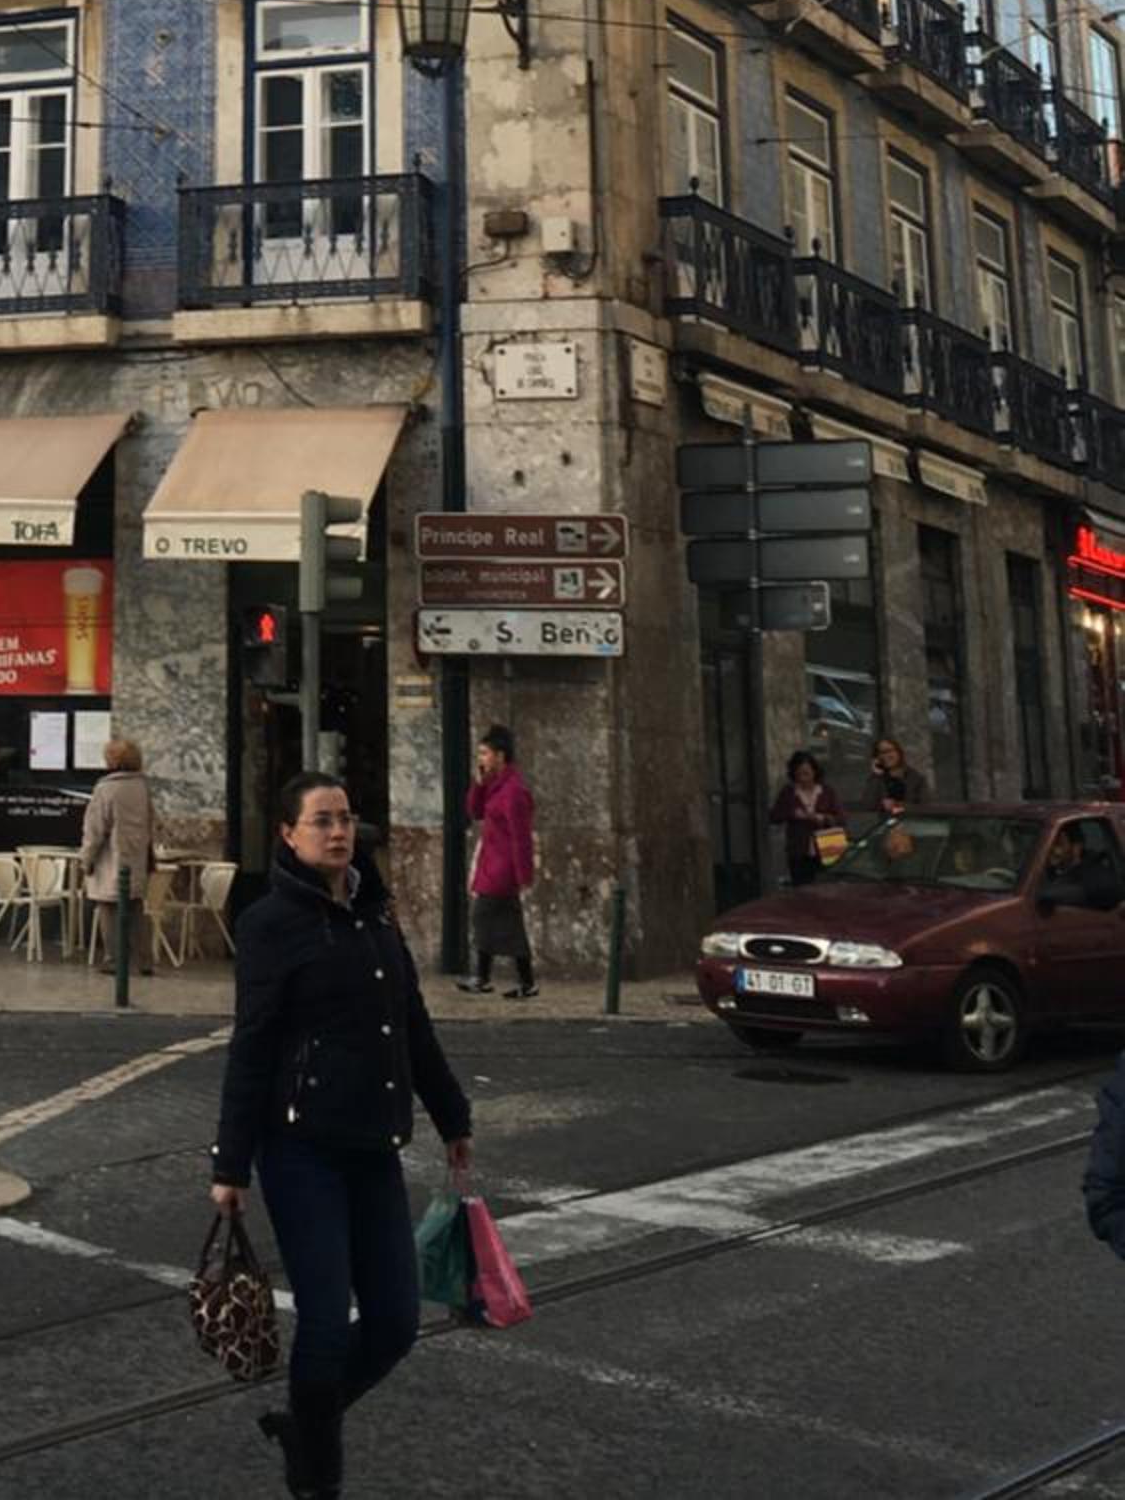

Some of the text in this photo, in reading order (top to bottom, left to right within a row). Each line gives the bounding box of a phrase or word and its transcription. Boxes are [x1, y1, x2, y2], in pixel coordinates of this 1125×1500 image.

[12, 519, 60, 541] TOFA
[505, 527, 545, 546] Real
[155, 537, 248, 555] O TREVO
[495, 620, 523, 644] S.
